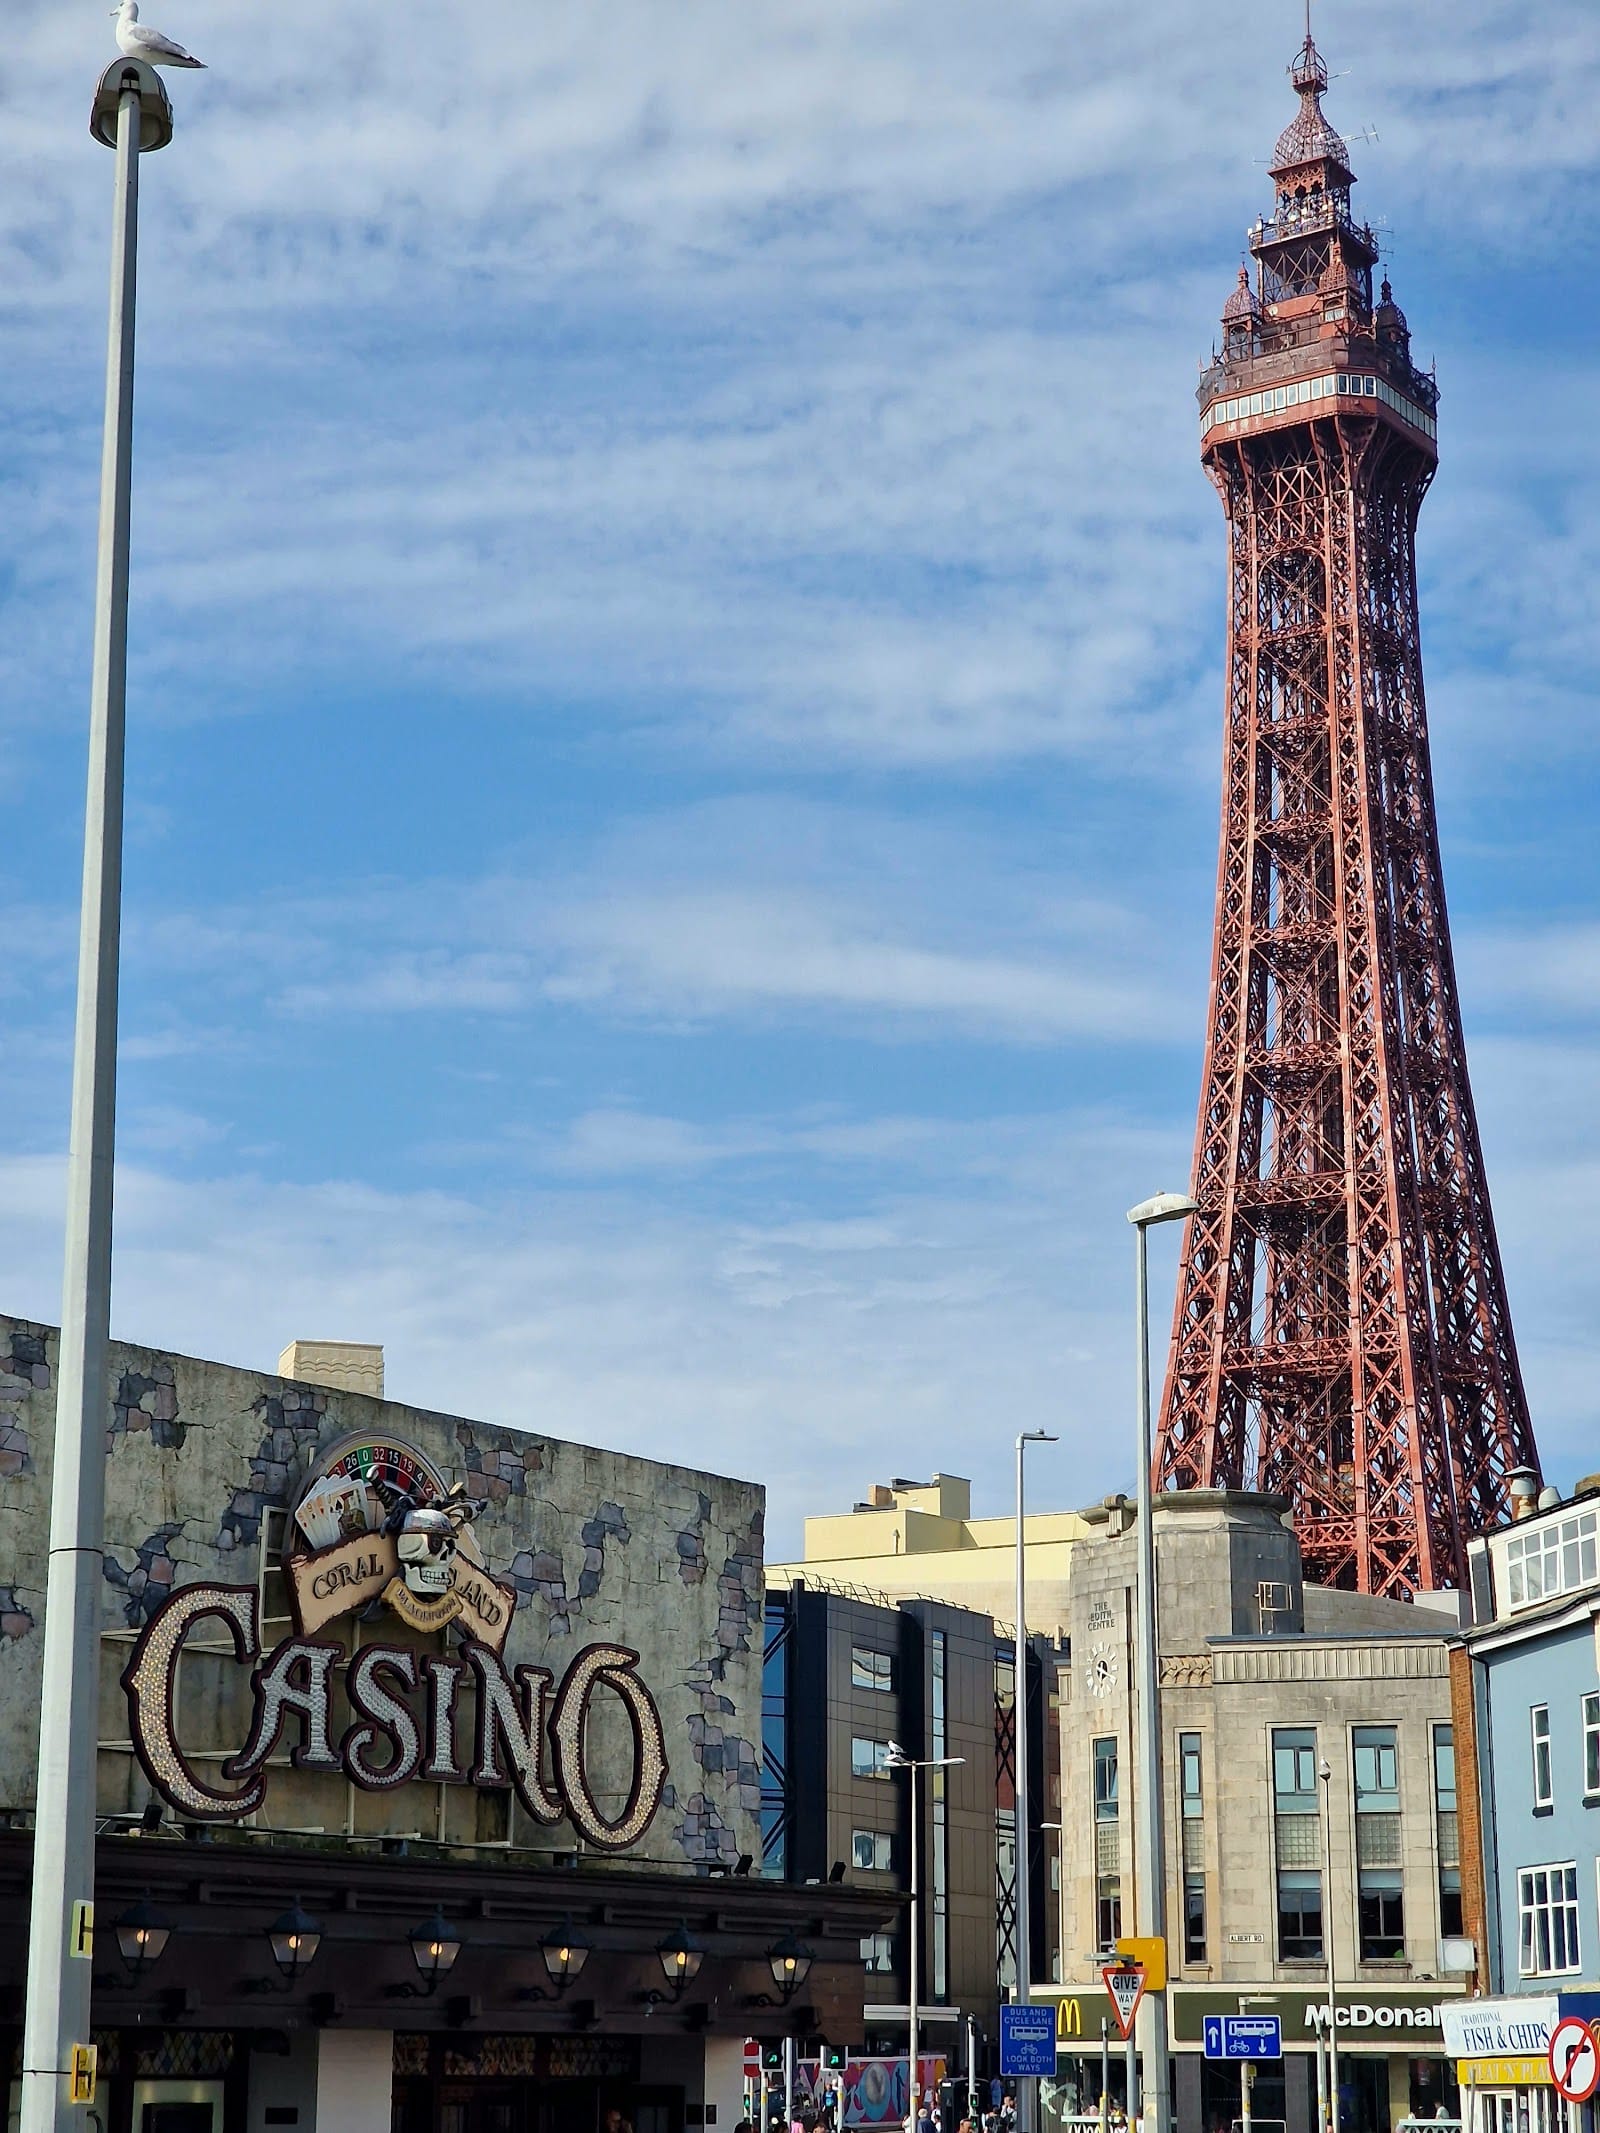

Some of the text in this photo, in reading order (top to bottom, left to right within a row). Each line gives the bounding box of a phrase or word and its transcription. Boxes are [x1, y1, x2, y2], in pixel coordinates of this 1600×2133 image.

[345, 1454, 358, 1469] 26
[362, 1450, 369, 1461] 0
[374, 1448, 385, 1460] 32
[387, 1451, 399, 1463] 15
[404, 1459, 413, 1472] 19
[417, 1472, 424, 1482] 4
[312, 1553, 384, 1599] CORAL
[1094, 1602, 1108, 1611] THE
[1090, 1610, 1112, 1622] EDITH
[1087, 1619, 1115, 1631] CENTRE
[121, 1583, 669, 1850] CASINO
[1112, 1976, 1138, 1990] GIVE
[1118, 1994, 1134, 2003] WAY
[1010, 2008, 1026, 2016] BUS
[1461, 2011, 1502, 2025] TRADITIONAL
[1032, 2017, 1054, 2025] LANE
[1463, 2022, 1550, 2051] FISH & CHIPS
[1007, 2055, 1027, 2063] LOOK
